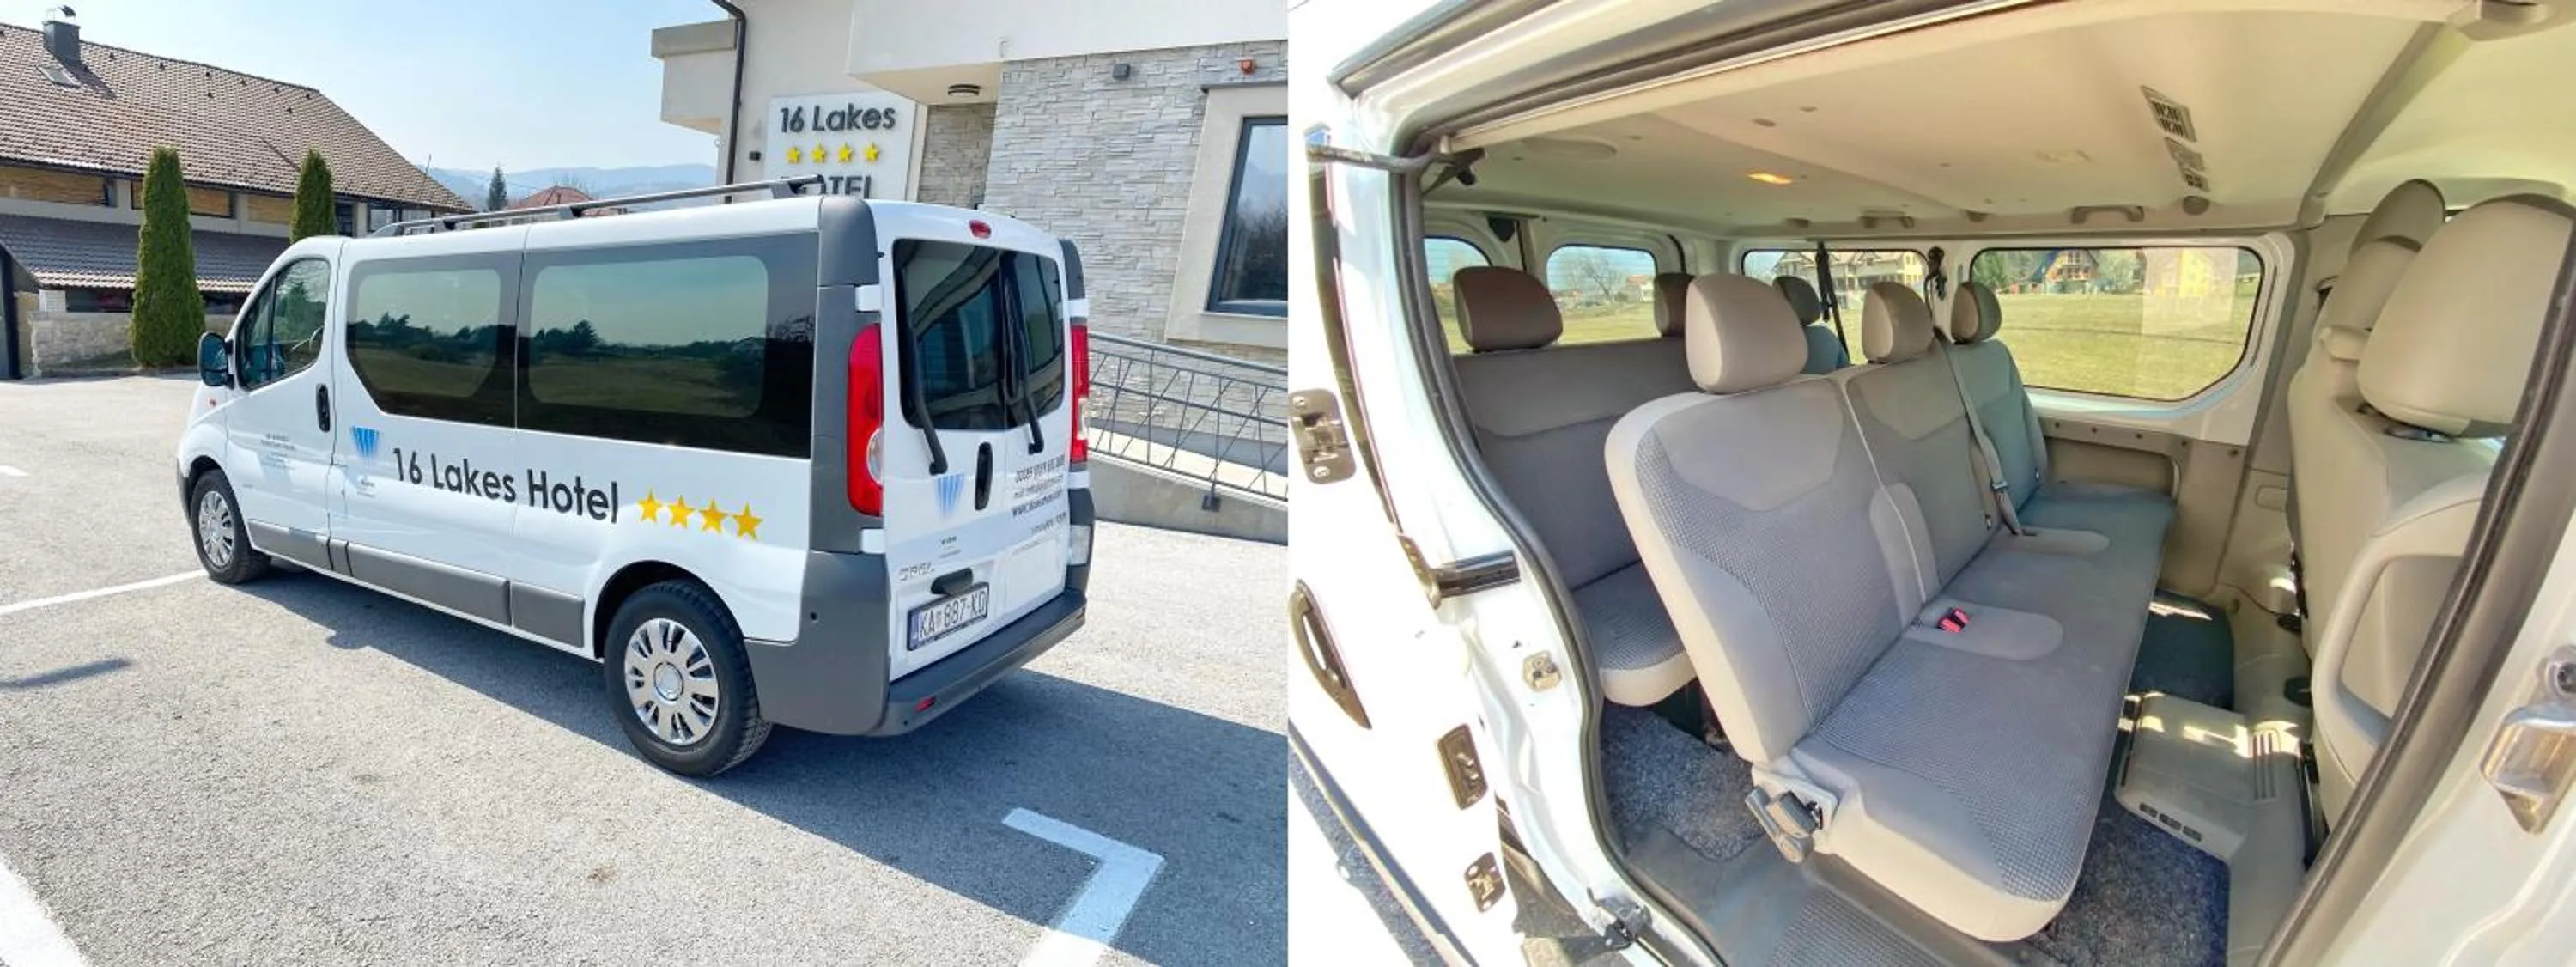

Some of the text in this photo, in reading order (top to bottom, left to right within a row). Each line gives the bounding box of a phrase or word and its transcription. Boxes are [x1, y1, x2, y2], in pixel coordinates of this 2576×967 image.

[780, 102, 896, 133] 16 Lakes
[392, 447, 618, 524] 16 Lakes Hotel
